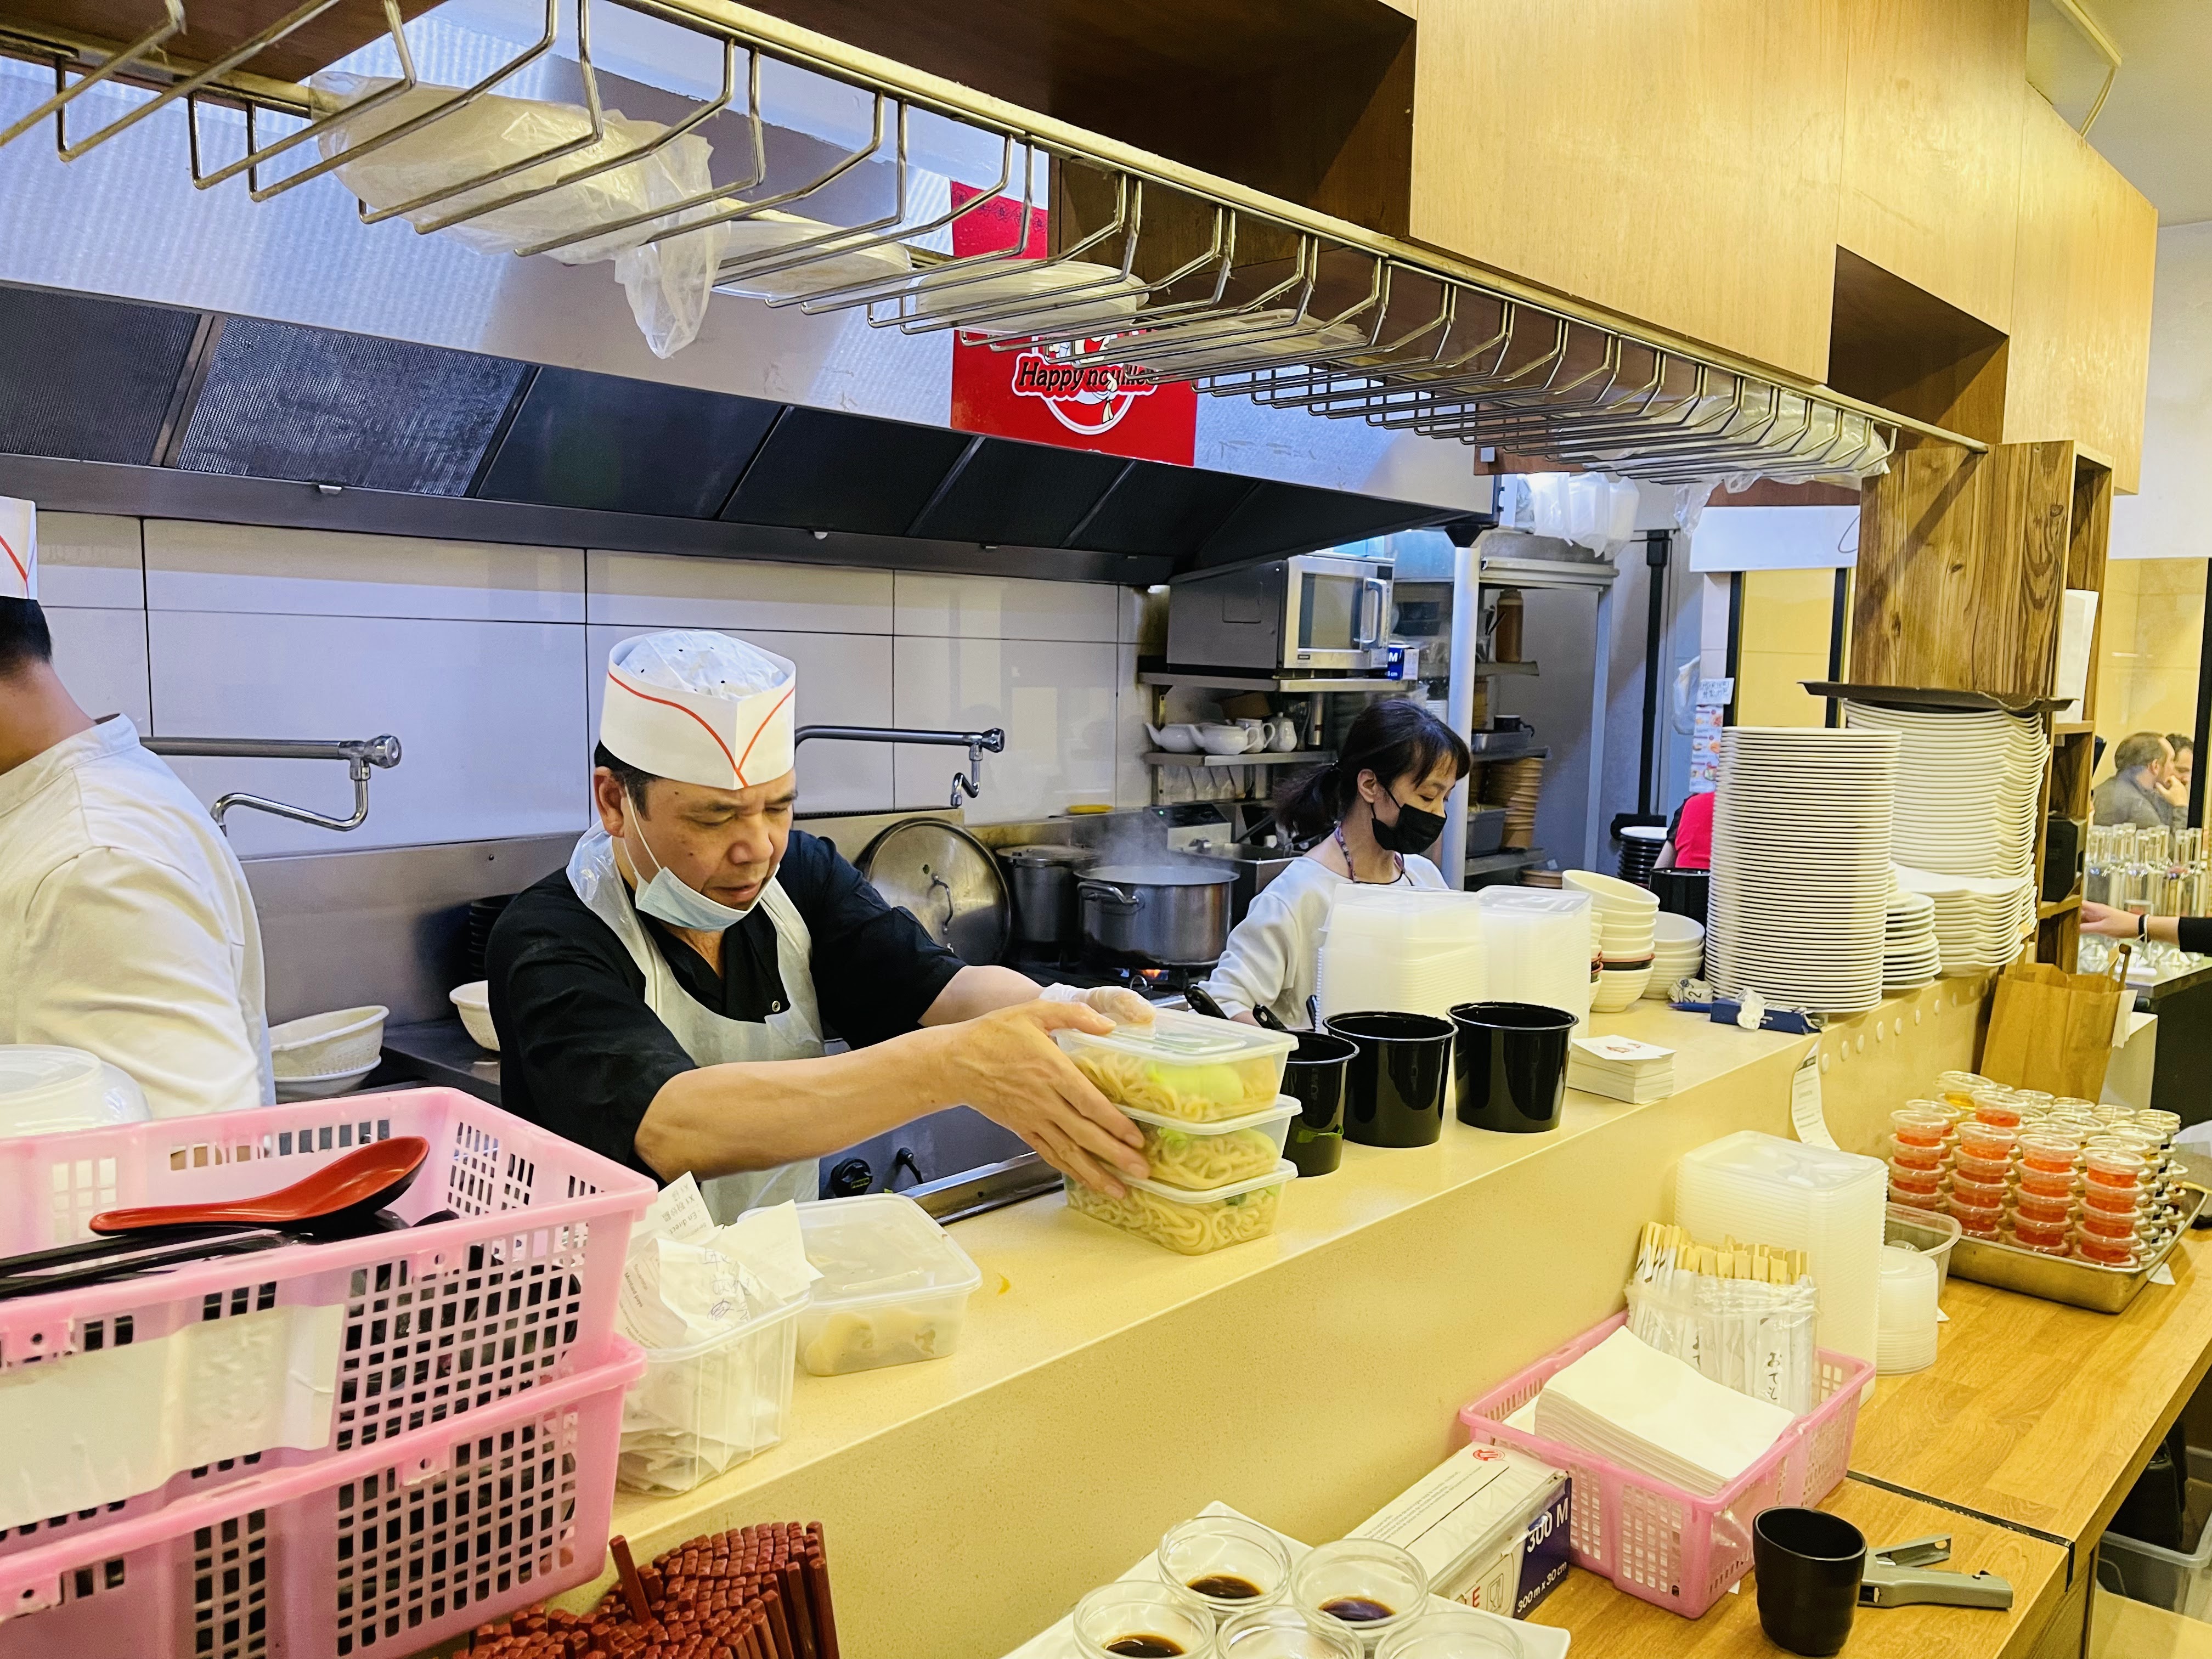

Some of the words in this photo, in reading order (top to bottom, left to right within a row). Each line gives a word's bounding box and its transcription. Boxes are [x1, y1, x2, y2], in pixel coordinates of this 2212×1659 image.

[1018, 361, 1085, 392] Happy
[1527, 1510, 1553, 1553] 300
[1556, 1497, 1568, 1528] M
[1547, 1568, 1557, 1585] 30
[1557, 1561, 1567, 1576] cm
